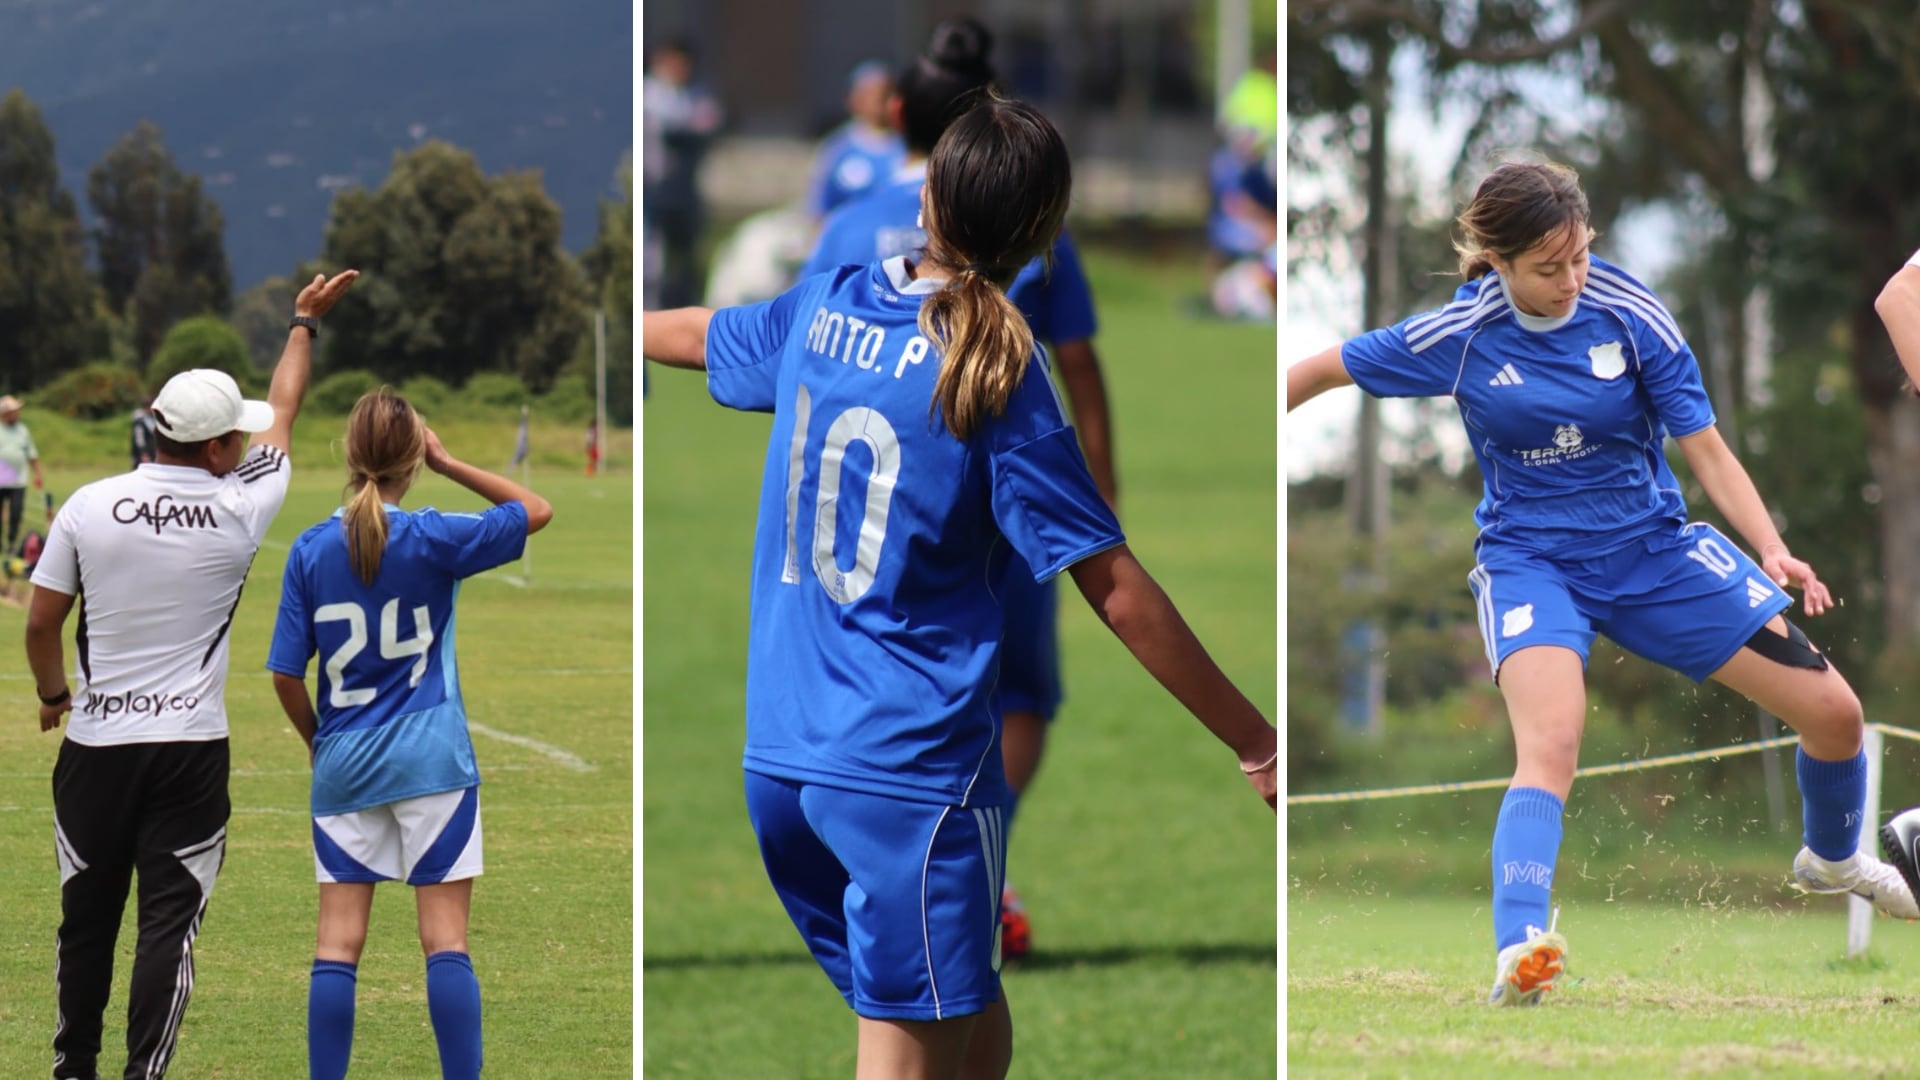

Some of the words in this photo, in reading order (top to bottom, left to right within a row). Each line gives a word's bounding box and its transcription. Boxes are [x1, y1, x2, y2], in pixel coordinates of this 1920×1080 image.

[807, 306, 884, 374] ANTO.
[894, 336, 929, 379] P
[781, 384, 901, 605] 10
[1687, 538, 1738, 580] 10
[314, 598, 434, 708] 24
